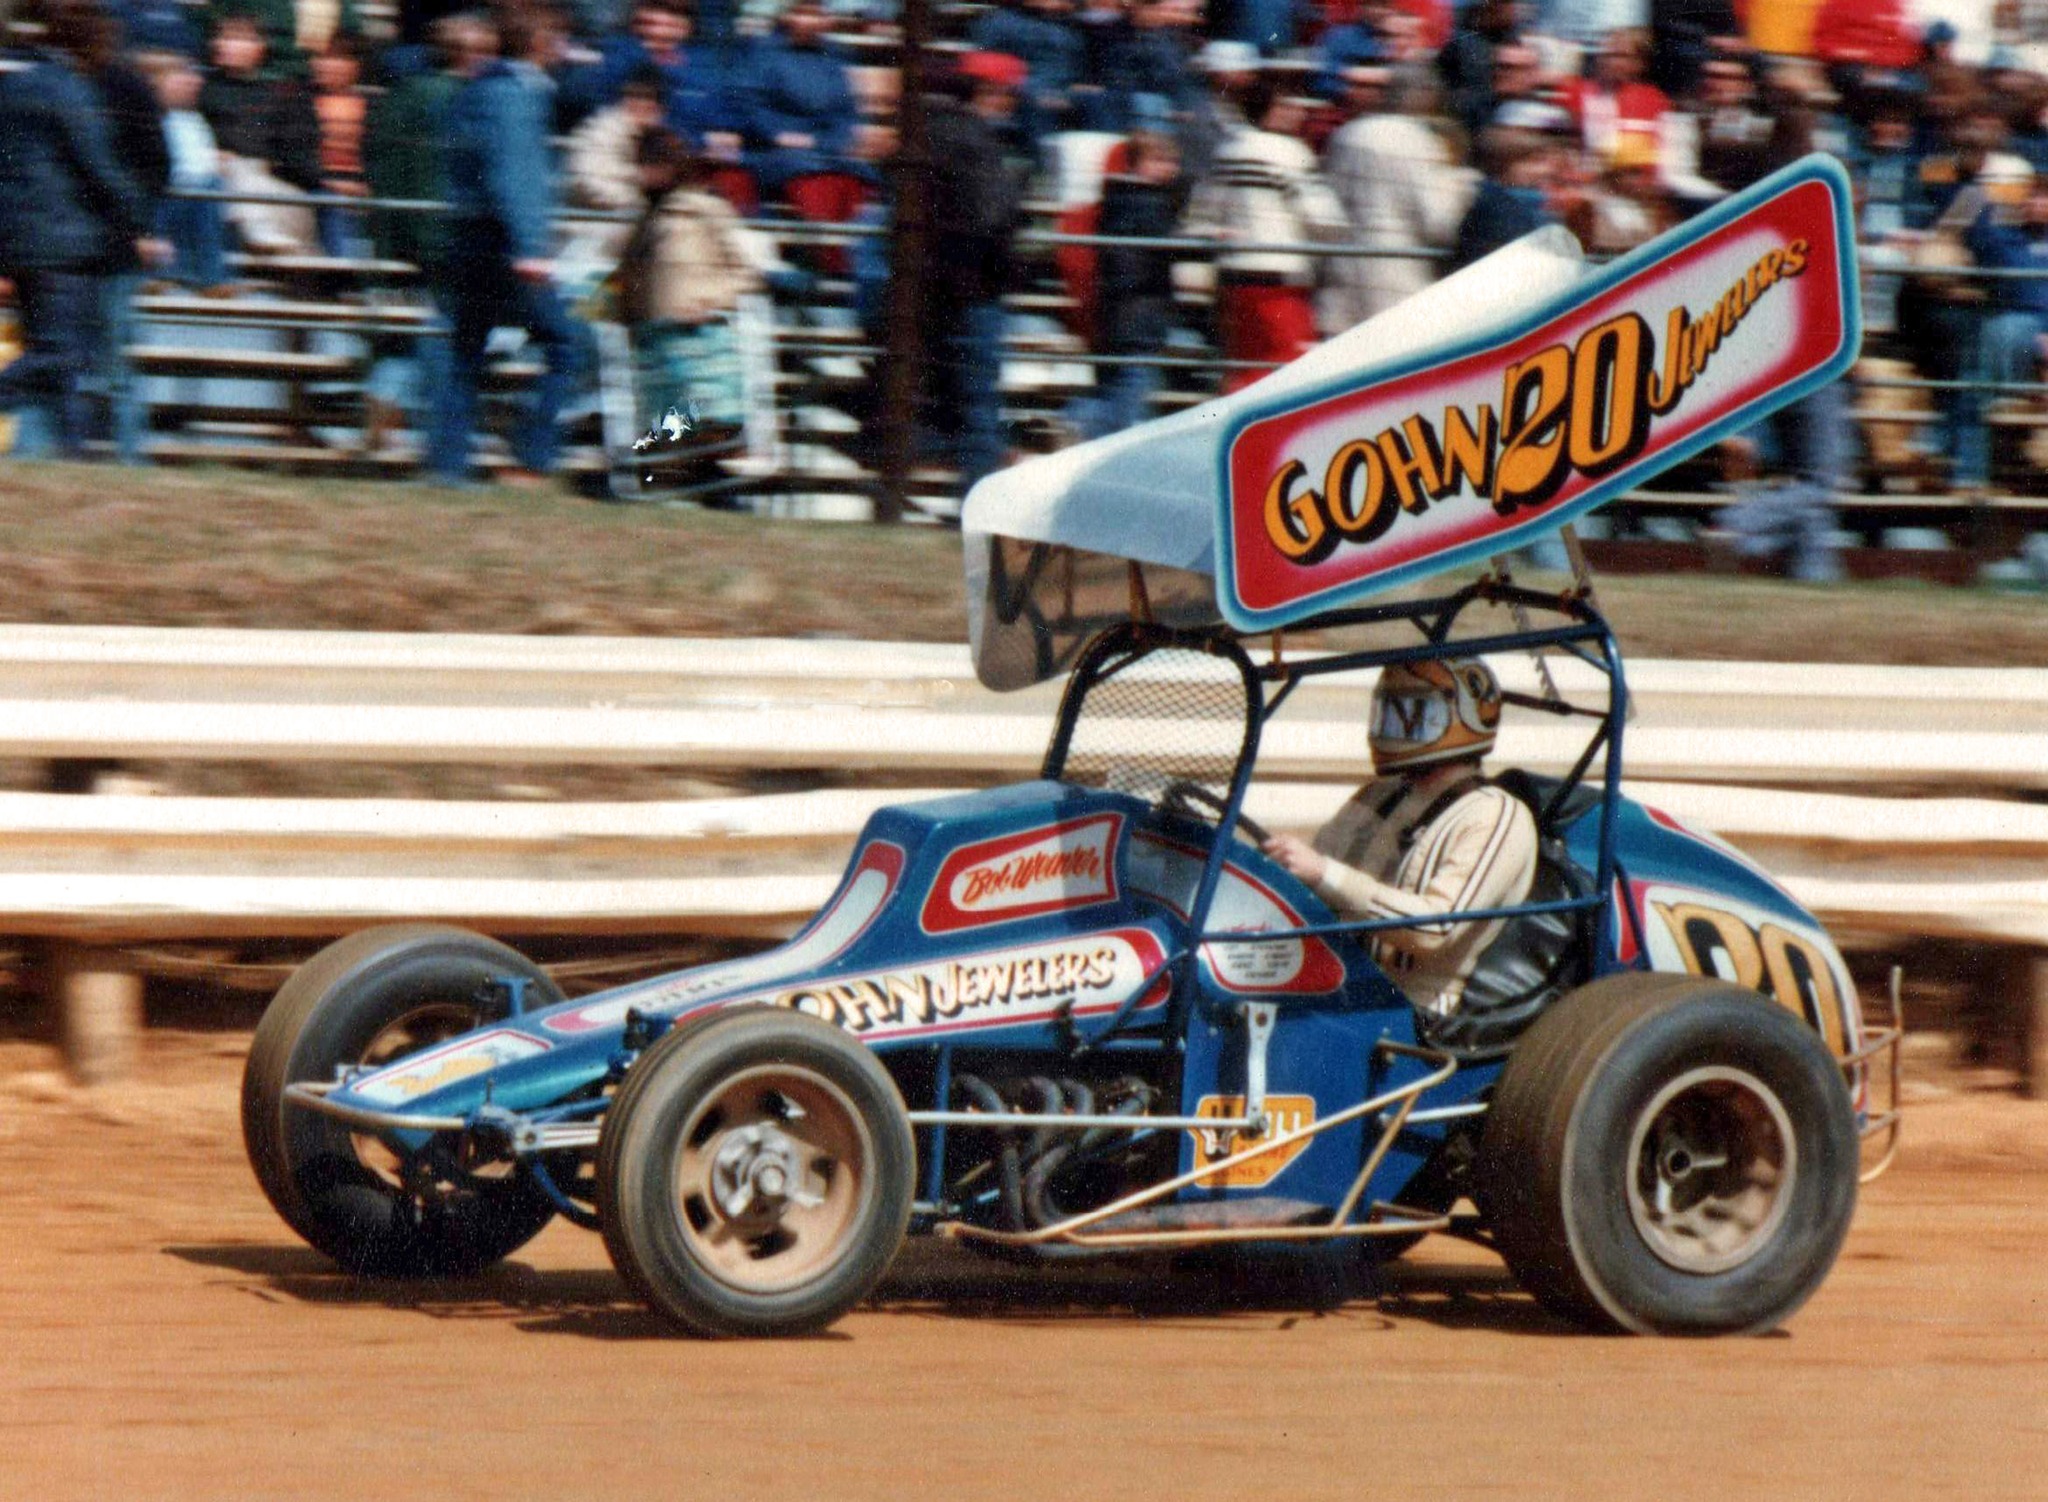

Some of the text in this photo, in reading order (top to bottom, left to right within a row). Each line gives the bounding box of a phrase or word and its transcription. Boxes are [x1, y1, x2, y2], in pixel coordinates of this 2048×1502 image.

[1264, 403, 1494, 565] GOHN
[1492, 311, 1656, 516] 20
[932, 948, 1116, 1018] JEWELERS
